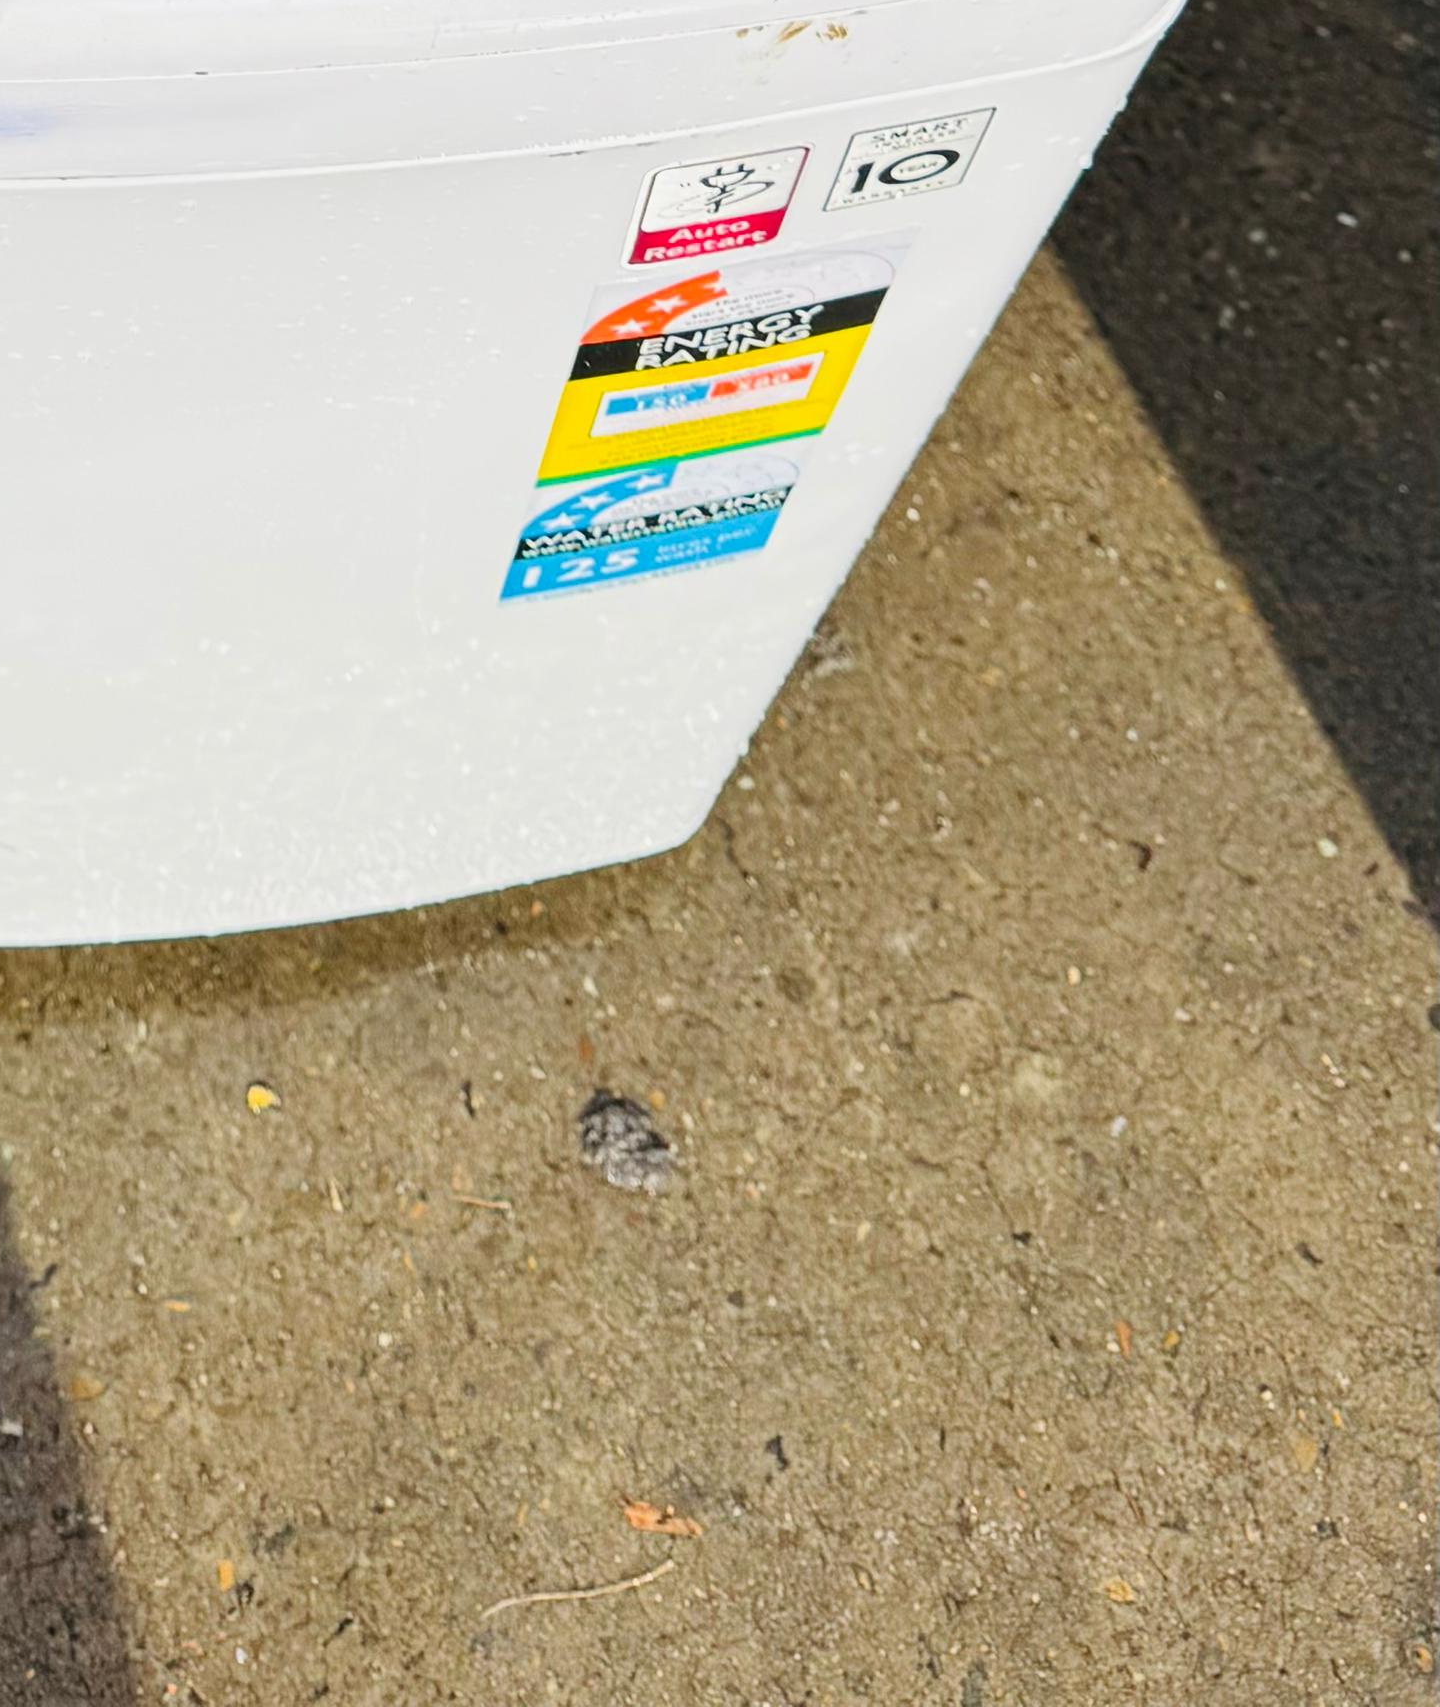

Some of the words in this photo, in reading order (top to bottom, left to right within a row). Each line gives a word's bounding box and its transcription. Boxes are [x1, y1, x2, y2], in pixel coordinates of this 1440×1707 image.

[851, 149, 960, 193] 10
[643, 228, 768, 262] Restart
[668, 218, 751, 244] Auto
[635, 324, 812, 371] RATING
[639, 304, 825, 355] ENERGY
[523, 515, 647, 549] WATER
